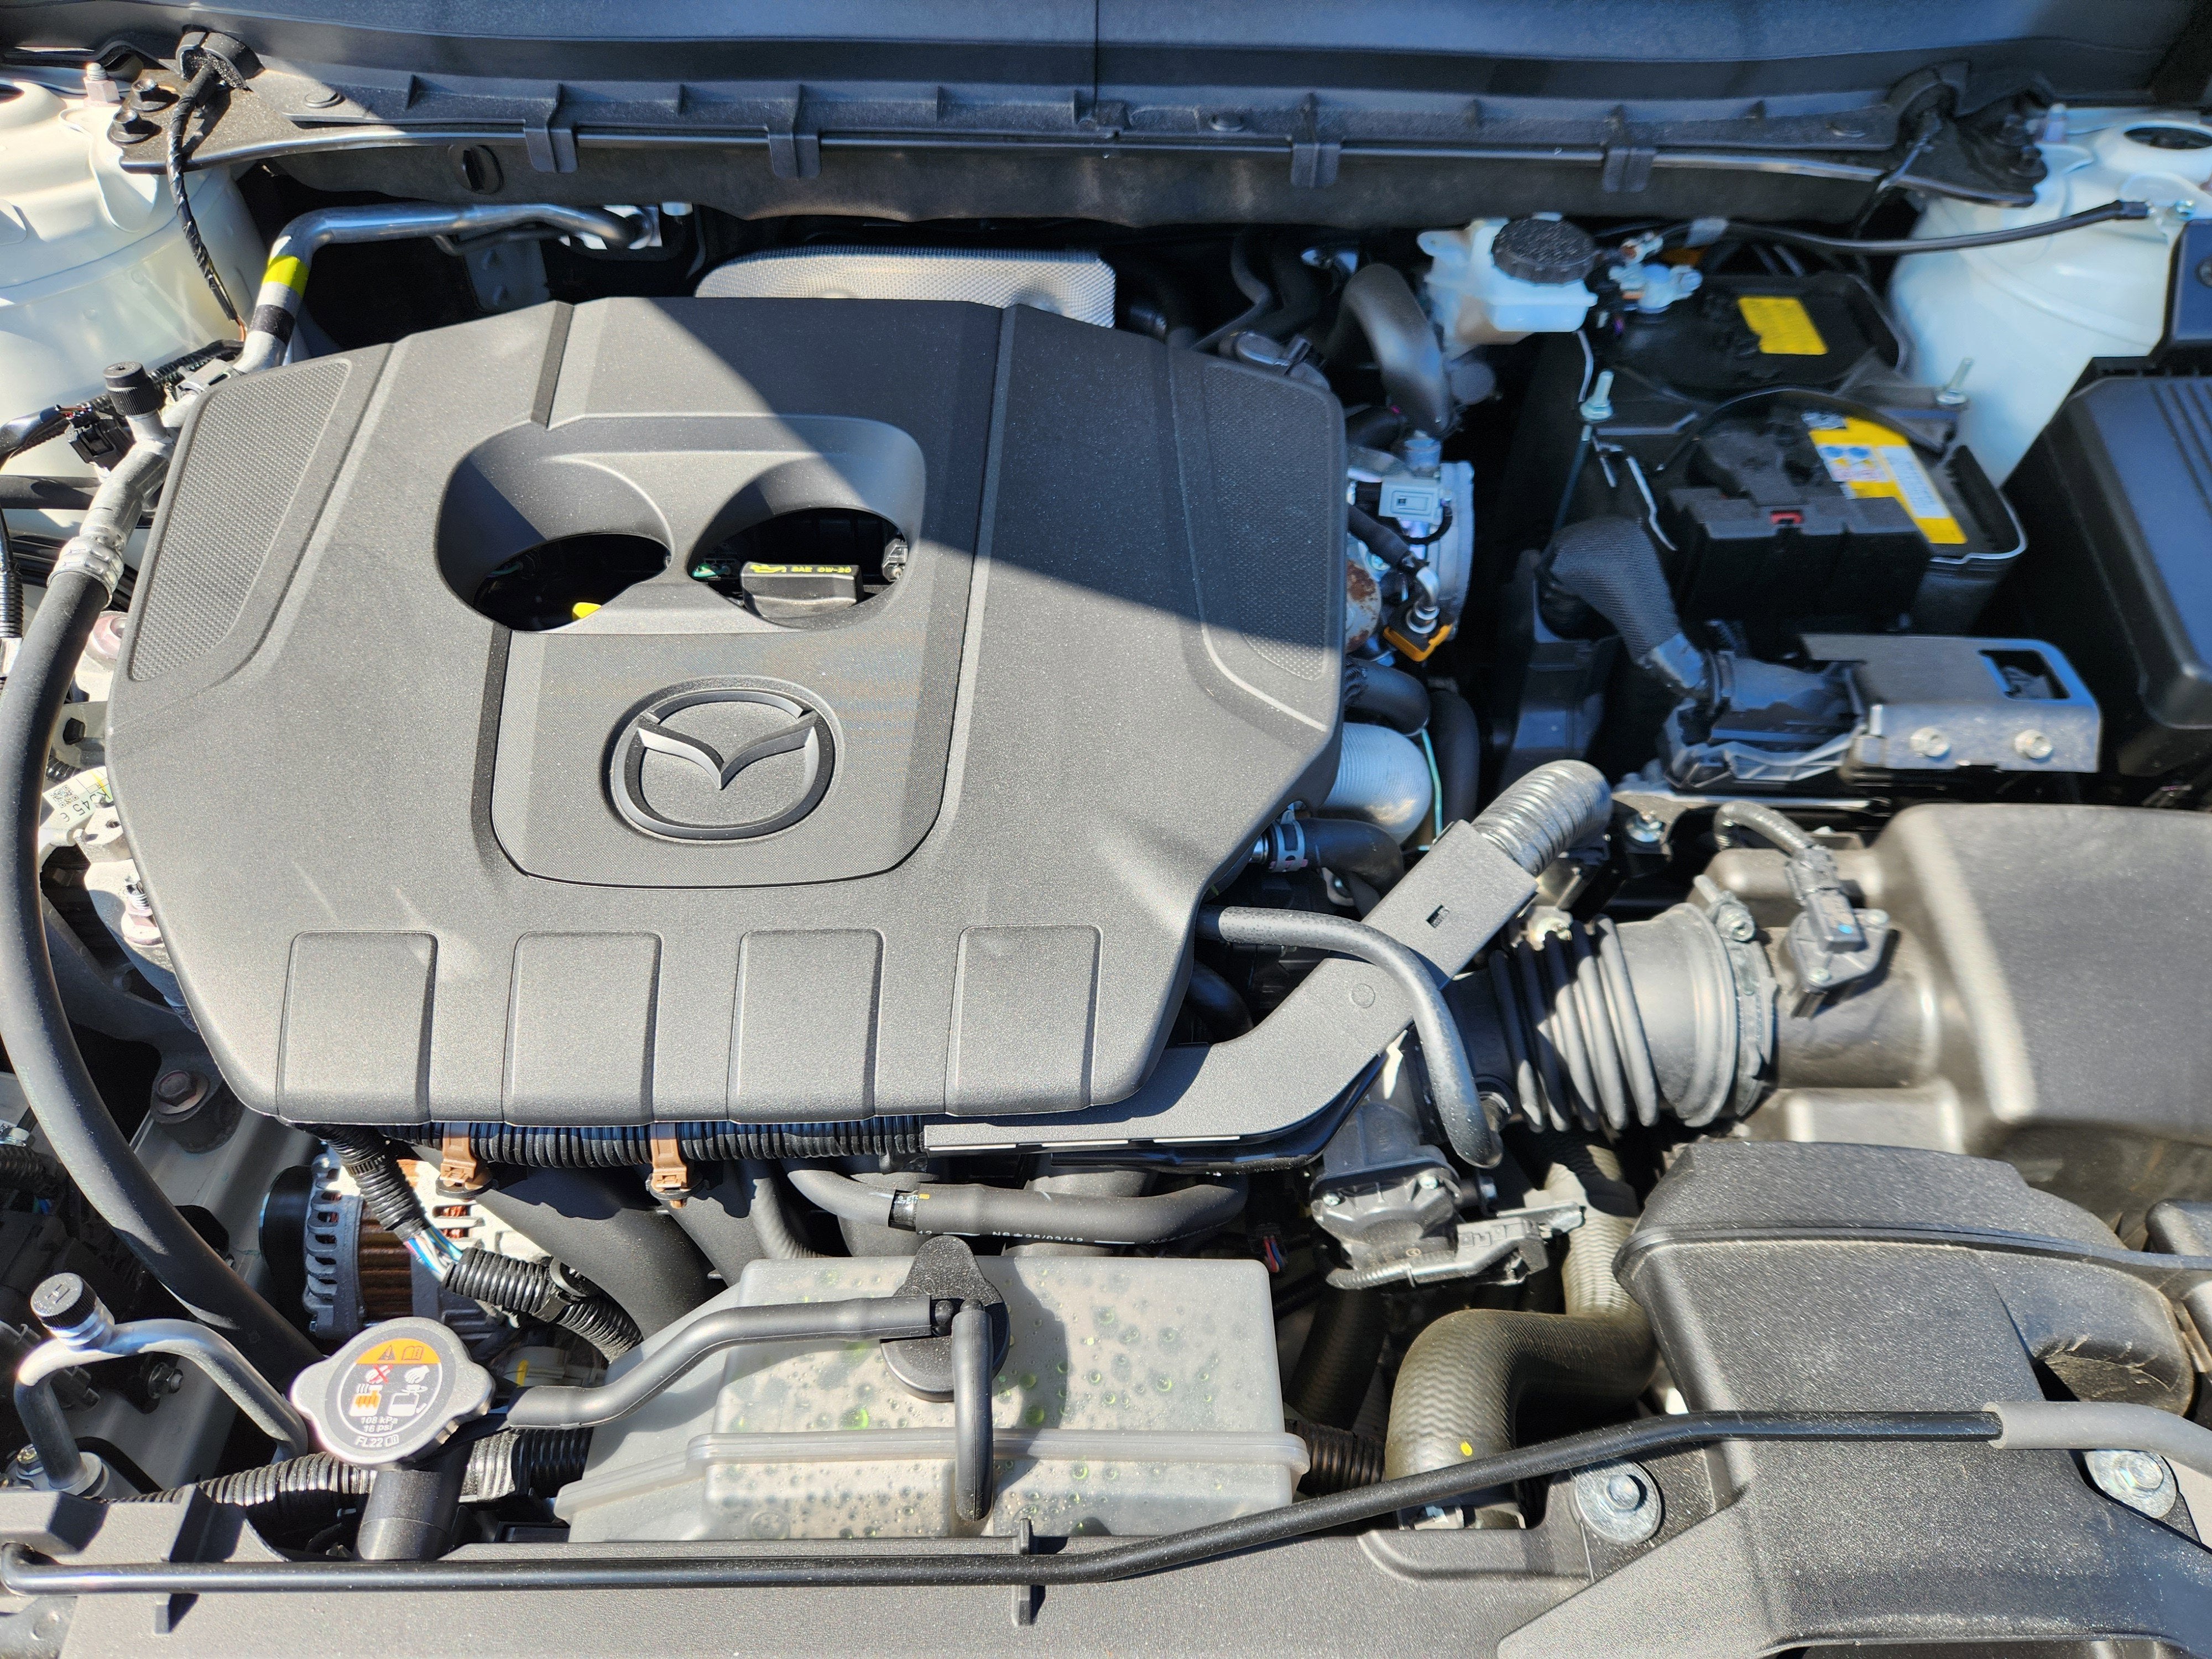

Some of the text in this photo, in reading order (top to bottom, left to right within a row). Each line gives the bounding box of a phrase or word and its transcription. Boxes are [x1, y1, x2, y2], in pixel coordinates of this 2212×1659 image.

[361, 1416, 398, 1425] 108 kPa
[376, 1422, 394, 1433] psi
[354, 1435, 384, 1448] FL22
